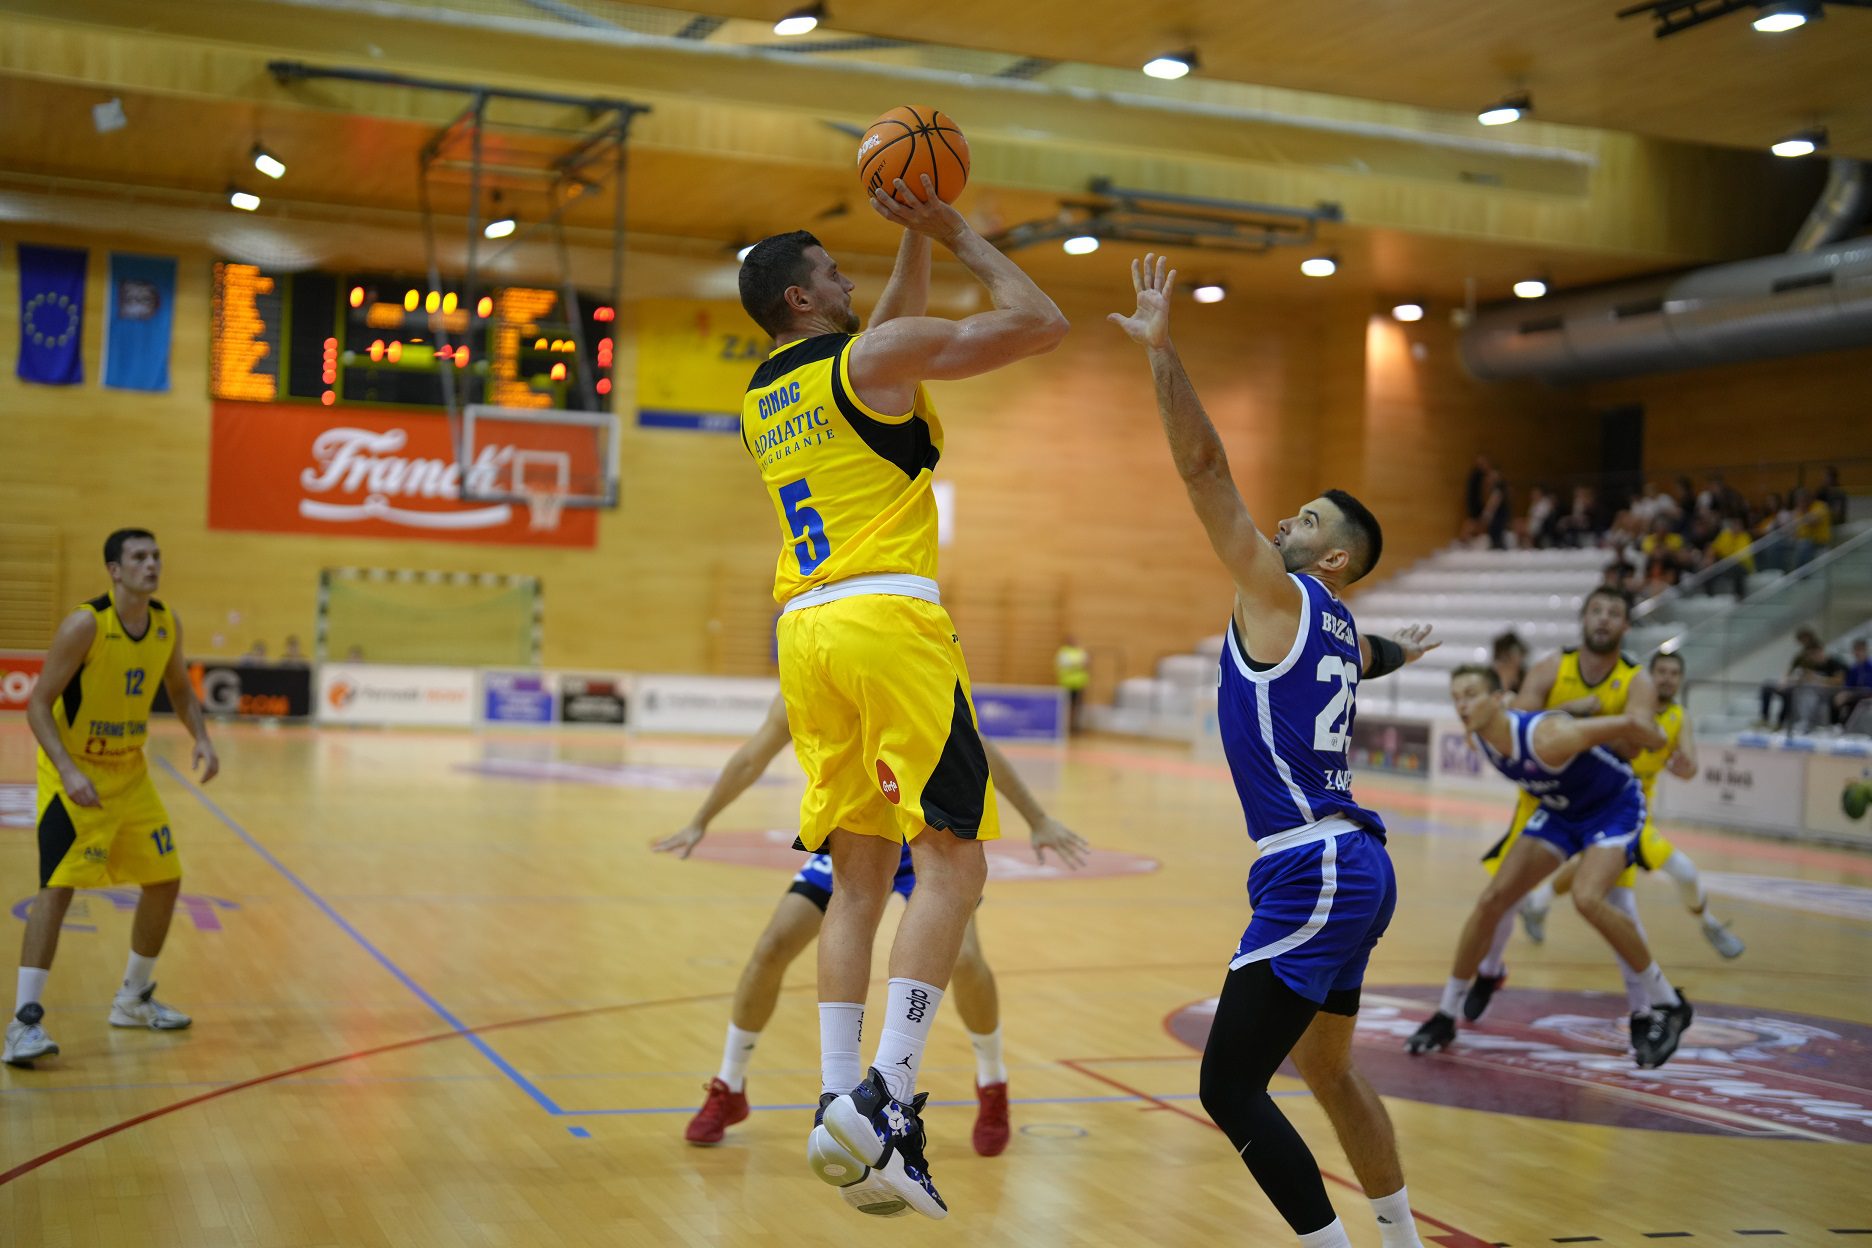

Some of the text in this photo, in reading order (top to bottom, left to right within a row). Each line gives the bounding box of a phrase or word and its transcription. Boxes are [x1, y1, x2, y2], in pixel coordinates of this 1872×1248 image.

[758, 382, 800, 420] CINAC
[755, 406, 829, 459] ADRIATIC
[778, 478, 831, 576] 5
[125, 667, 145, 696] 12
[89, 720, 125, 737] TERME
[151, 825, 174, 855] 12
